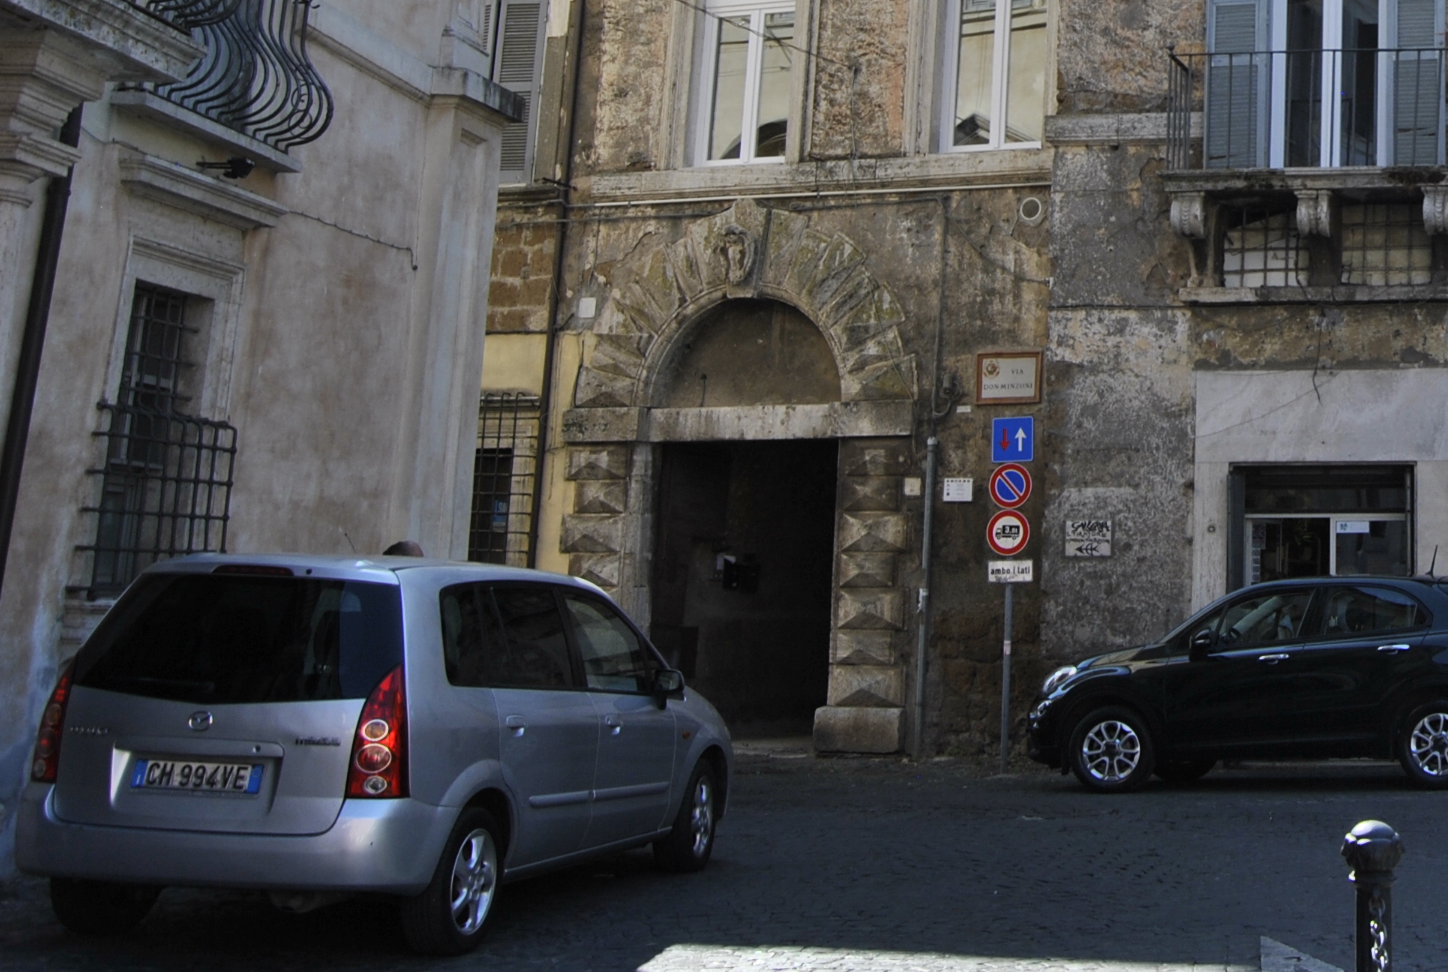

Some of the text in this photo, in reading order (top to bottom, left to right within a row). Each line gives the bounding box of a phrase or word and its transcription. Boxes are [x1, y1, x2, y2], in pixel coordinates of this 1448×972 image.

[1000, 382, 1033, 390] MINZONI
[990, 566, 1010, 575] ambo
[146, 762, 173, 788] CH
[178, 764, 250, 793] 994VE
